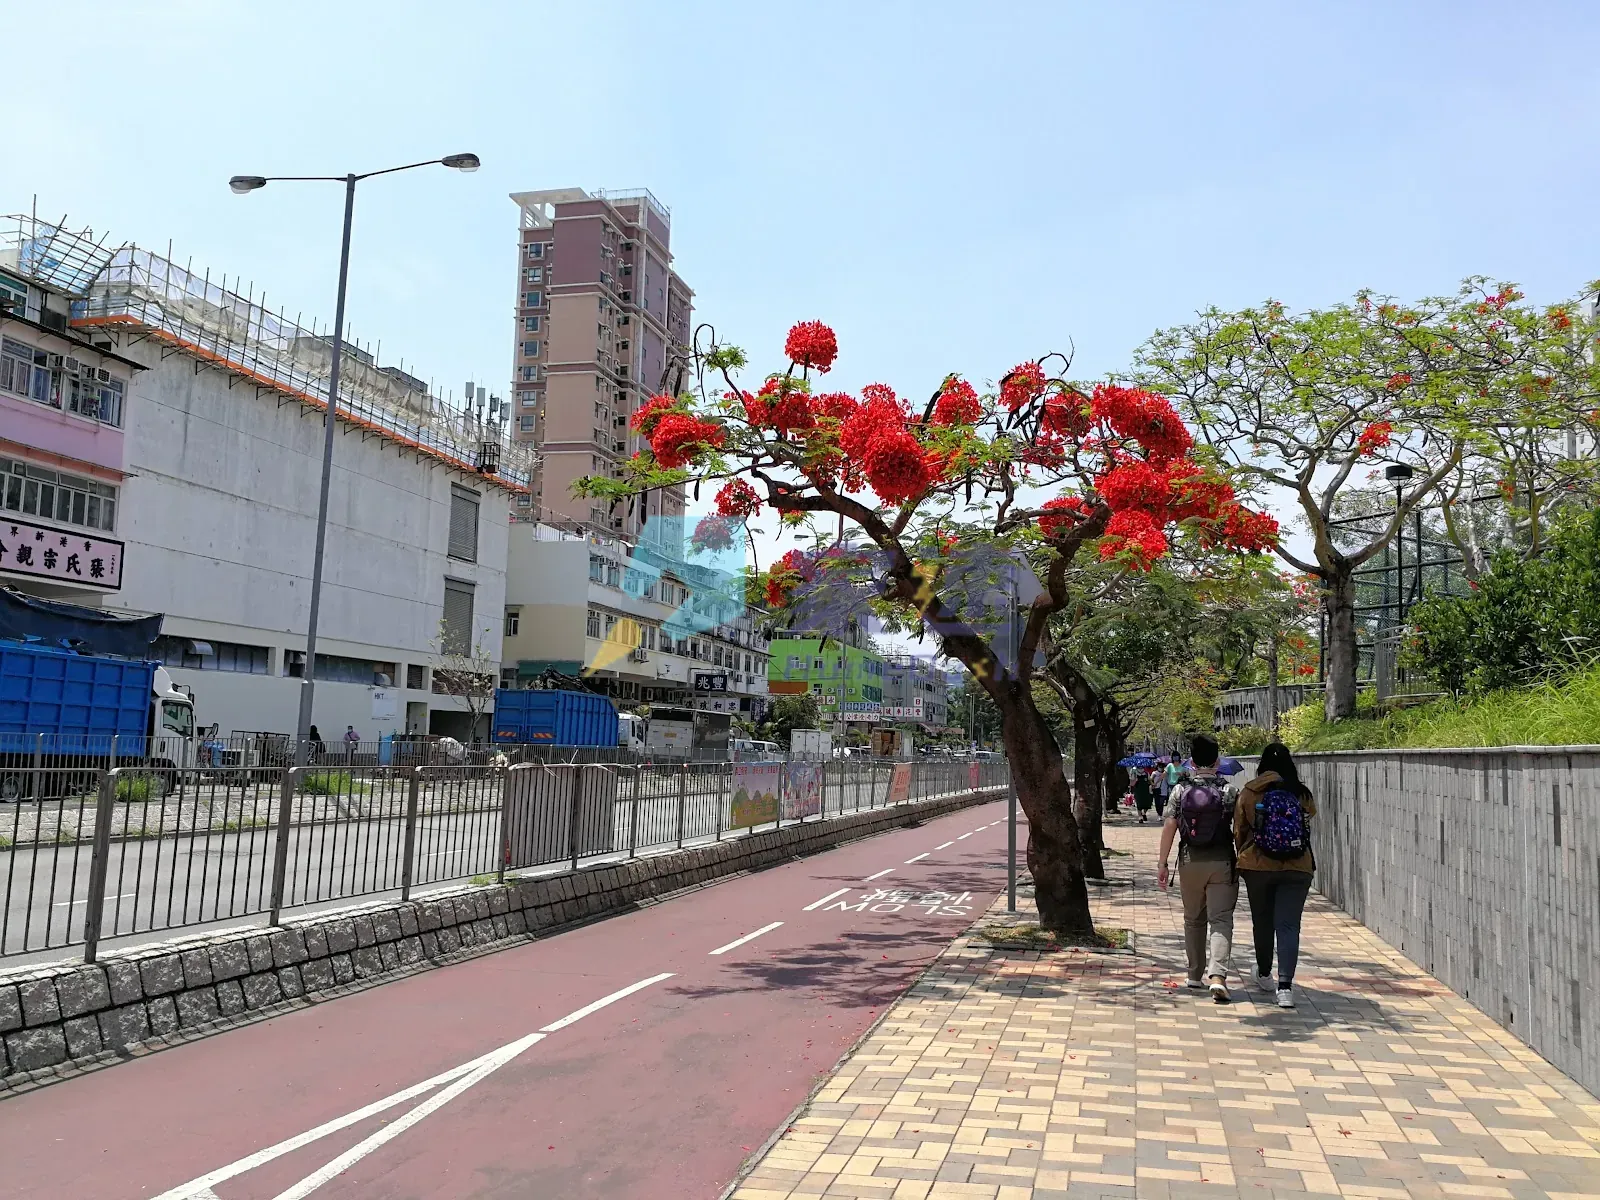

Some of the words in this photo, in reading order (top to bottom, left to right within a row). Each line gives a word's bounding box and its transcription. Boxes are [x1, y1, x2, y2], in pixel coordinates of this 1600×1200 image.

[10, 525, 92, 552] 香港新界
[822, 900, 973, 916] SLOW
